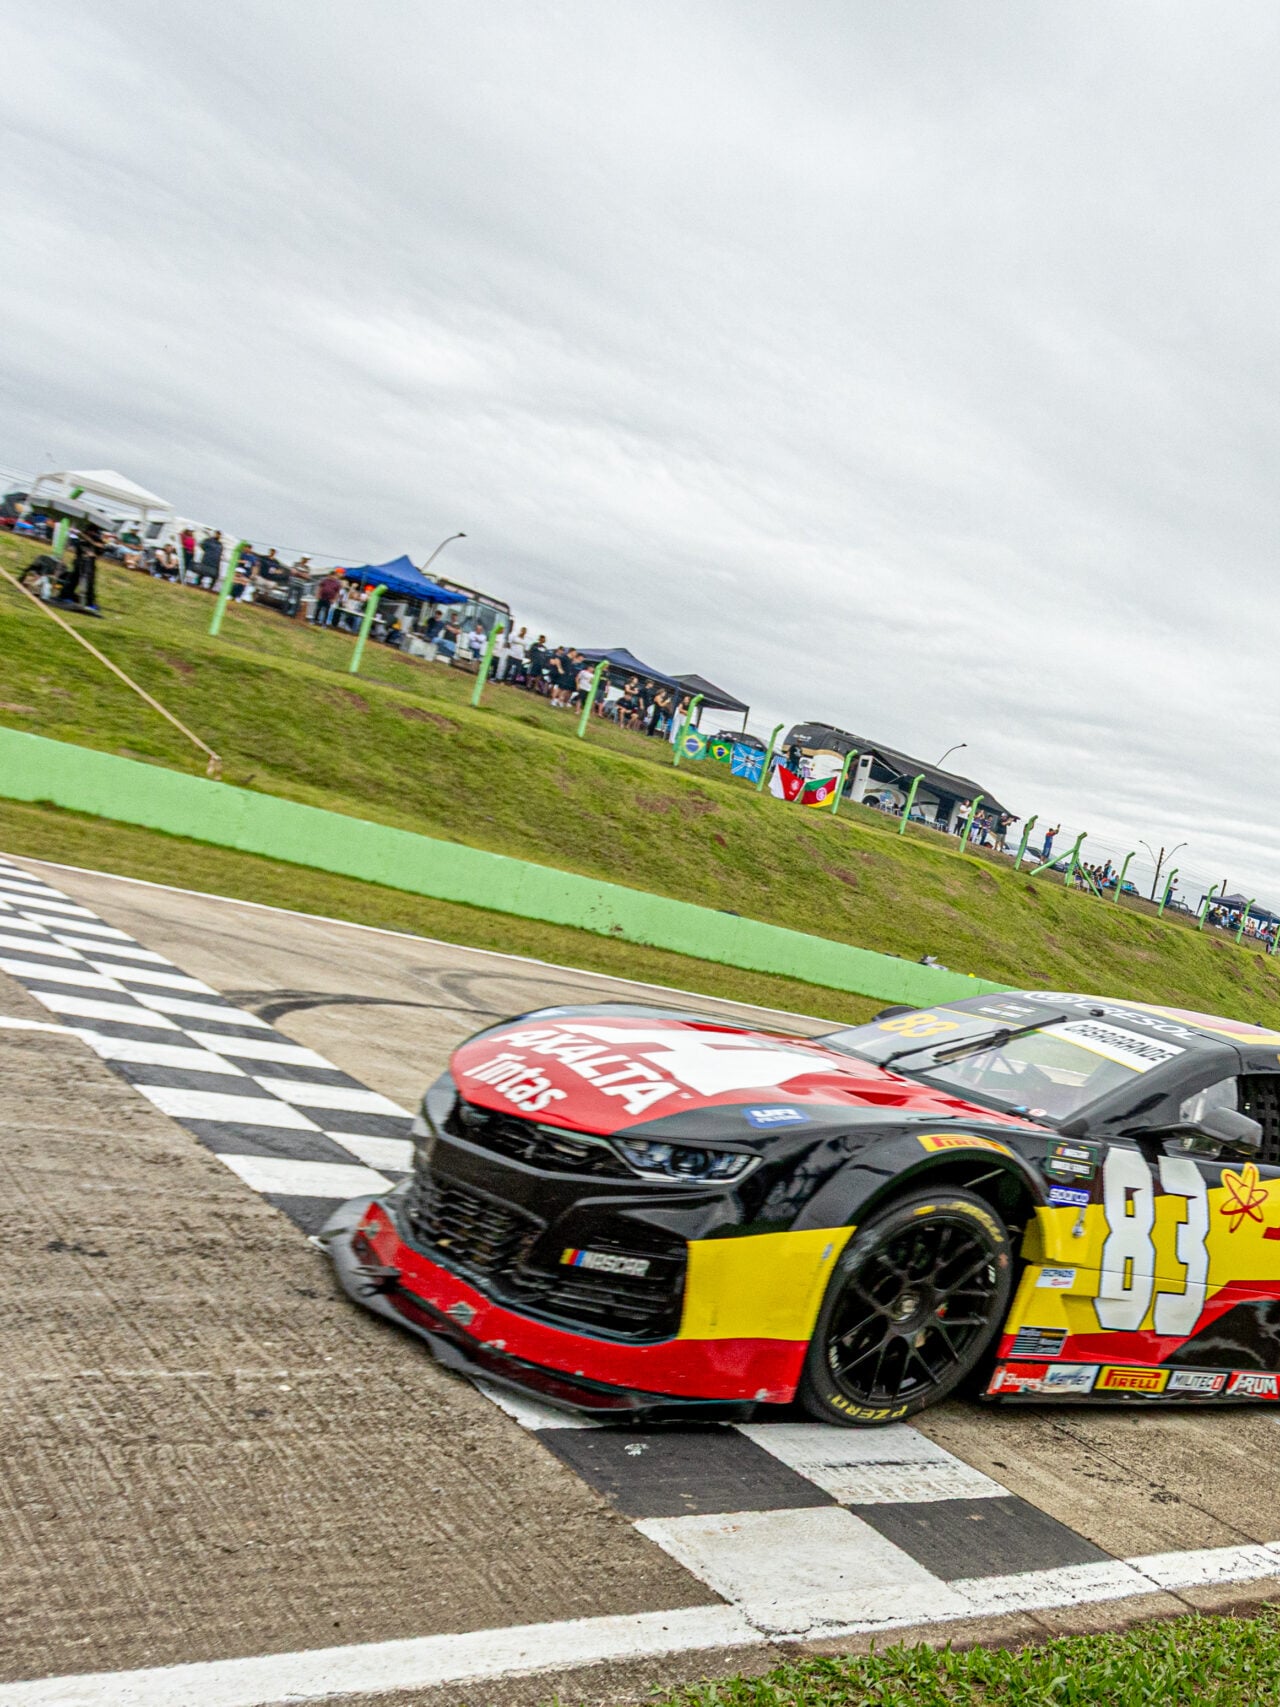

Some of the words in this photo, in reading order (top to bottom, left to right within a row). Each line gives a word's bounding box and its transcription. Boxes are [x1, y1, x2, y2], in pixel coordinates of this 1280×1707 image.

[878, 1013, 960, 1038] 83
[1074, 1003, 1201, 1041] CRESOL
[1065, 1024, 1178, 1062] CASAGRANDE
[462, 1053, 567, 1112] Tintas
[488, 1030, 680, 1115] AXALTA
[1092, 1146, 1211, 1337] 83
[581, 1250, 651, 1277] NASCAR
[1104, 1369, 1161, 1389] PIRELLI
